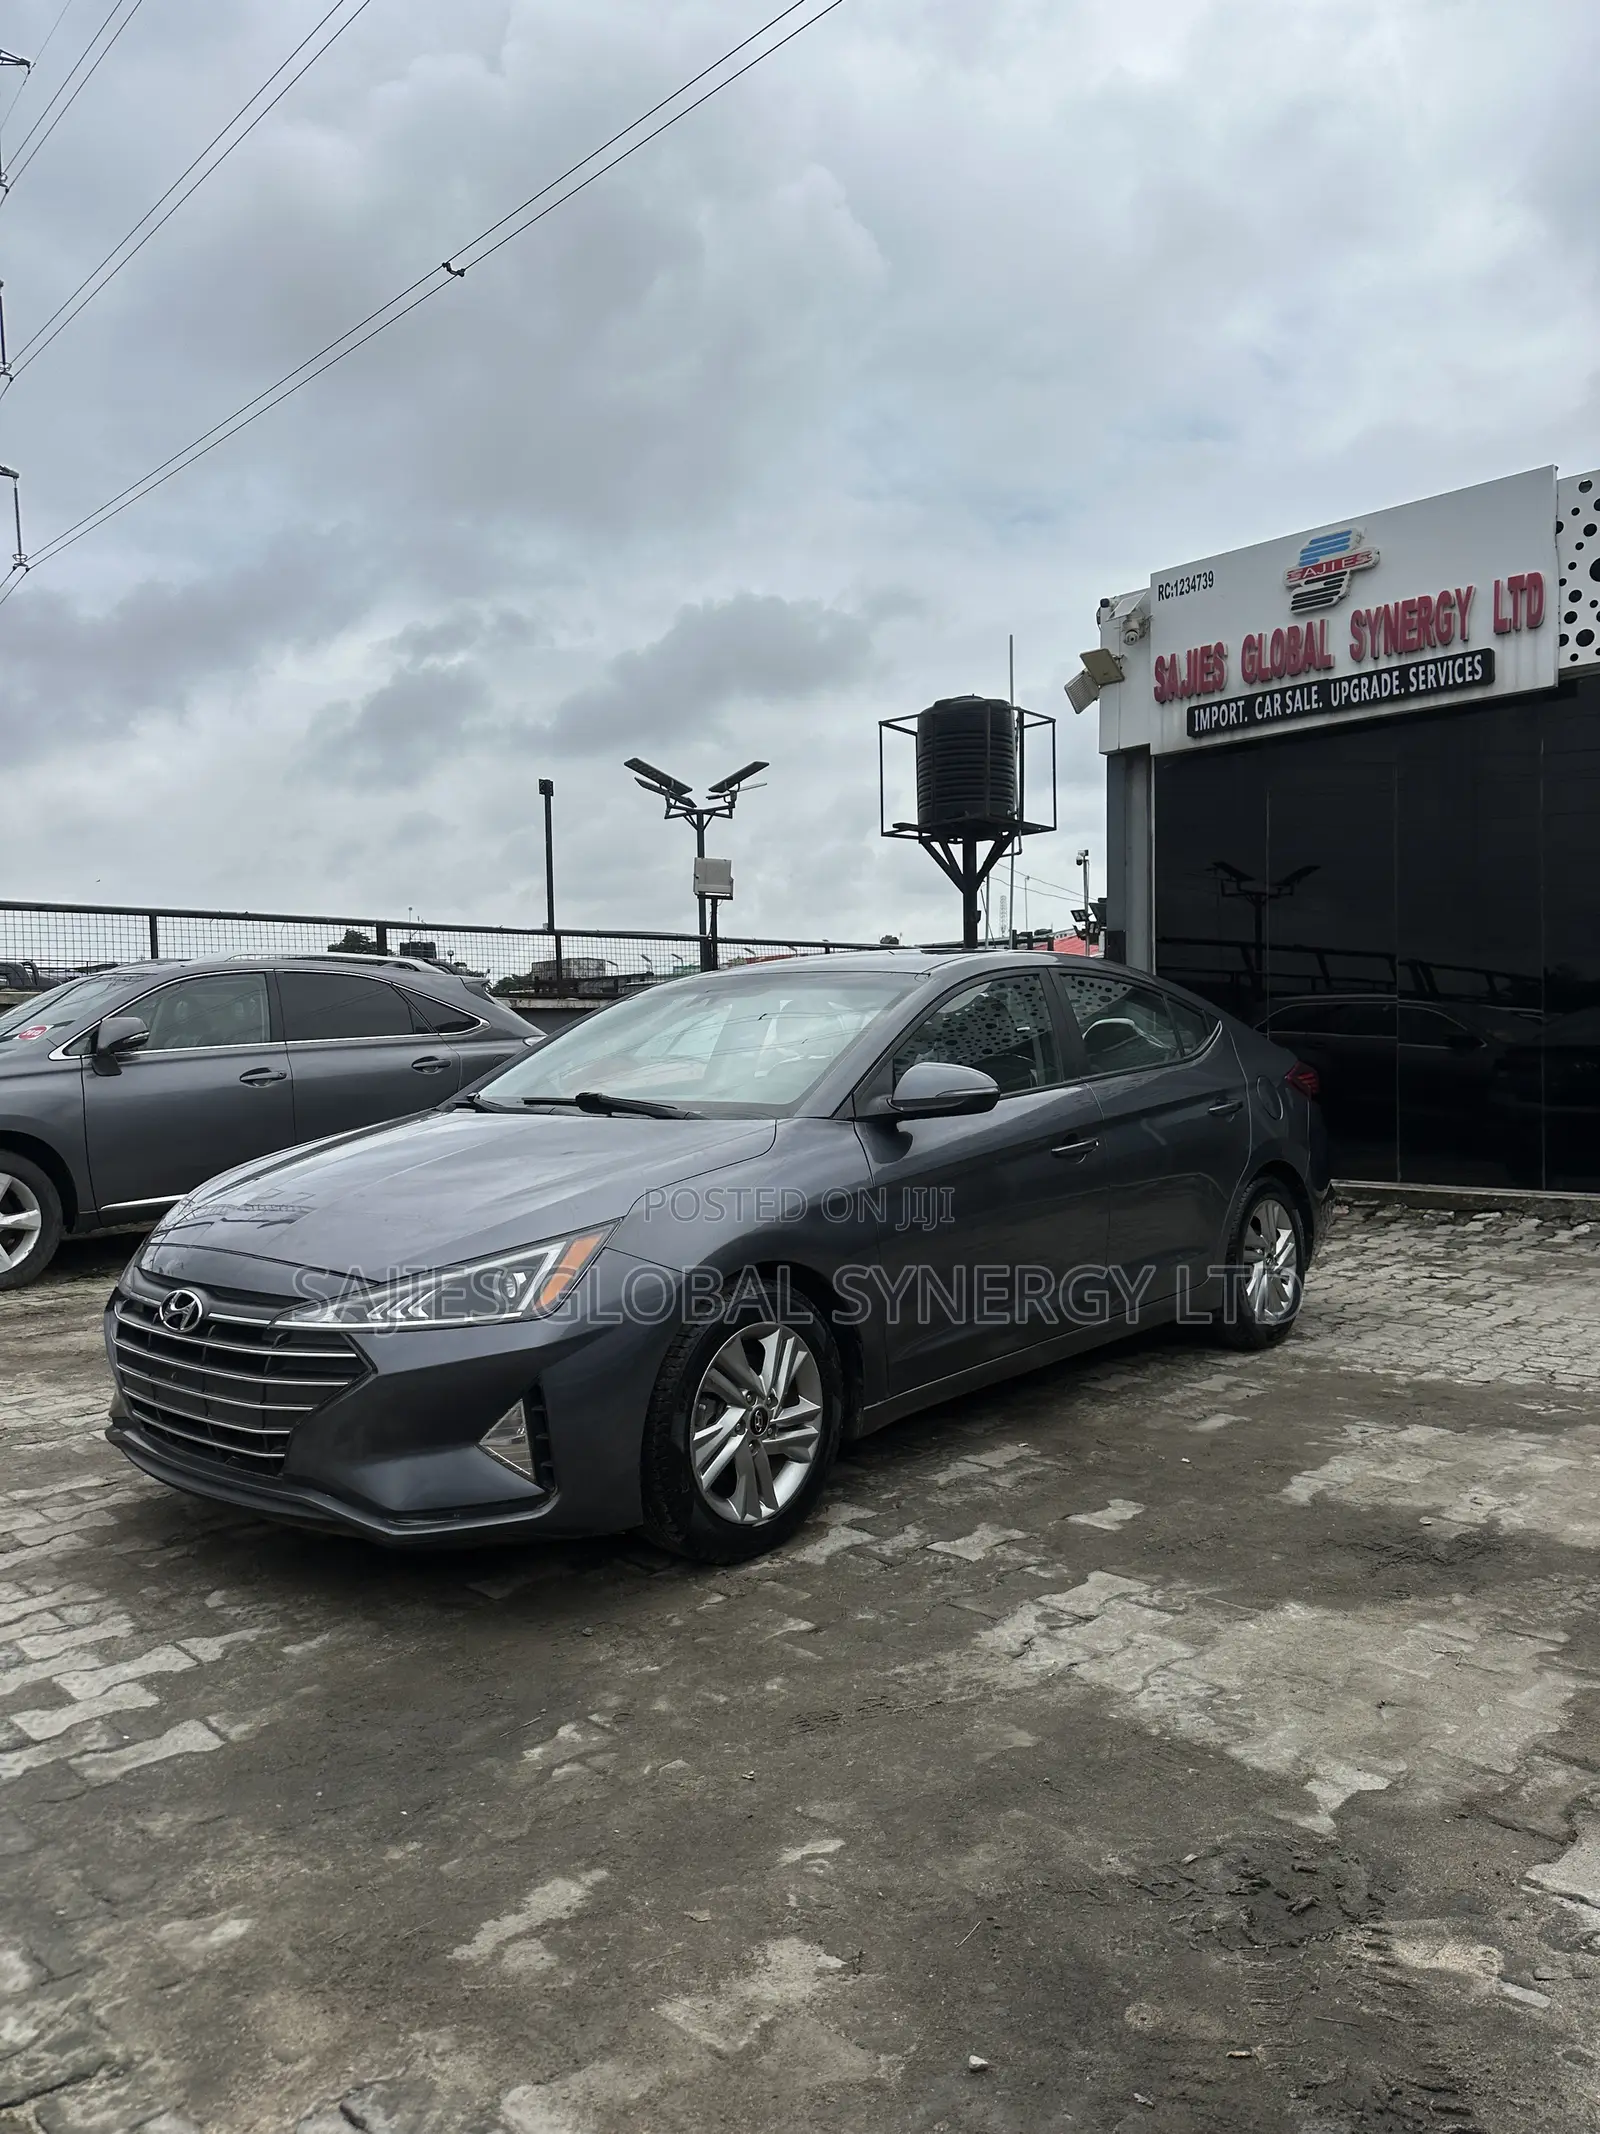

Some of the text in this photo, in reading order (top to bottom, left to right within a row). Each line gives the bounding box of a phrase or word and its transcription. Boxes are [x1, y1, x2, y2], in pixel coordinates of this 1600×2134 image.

[1158, 570, 1214, 601] RC:1234739
[1288, 552, 1372, 582] SAJIES
[1154, 572, 1544, 703] SAJIES GLOBAL SYNERGY LTD
[1194, 654, 1482, 732] IMPORT. CAR SALE. UPGRADE. SERVICES
